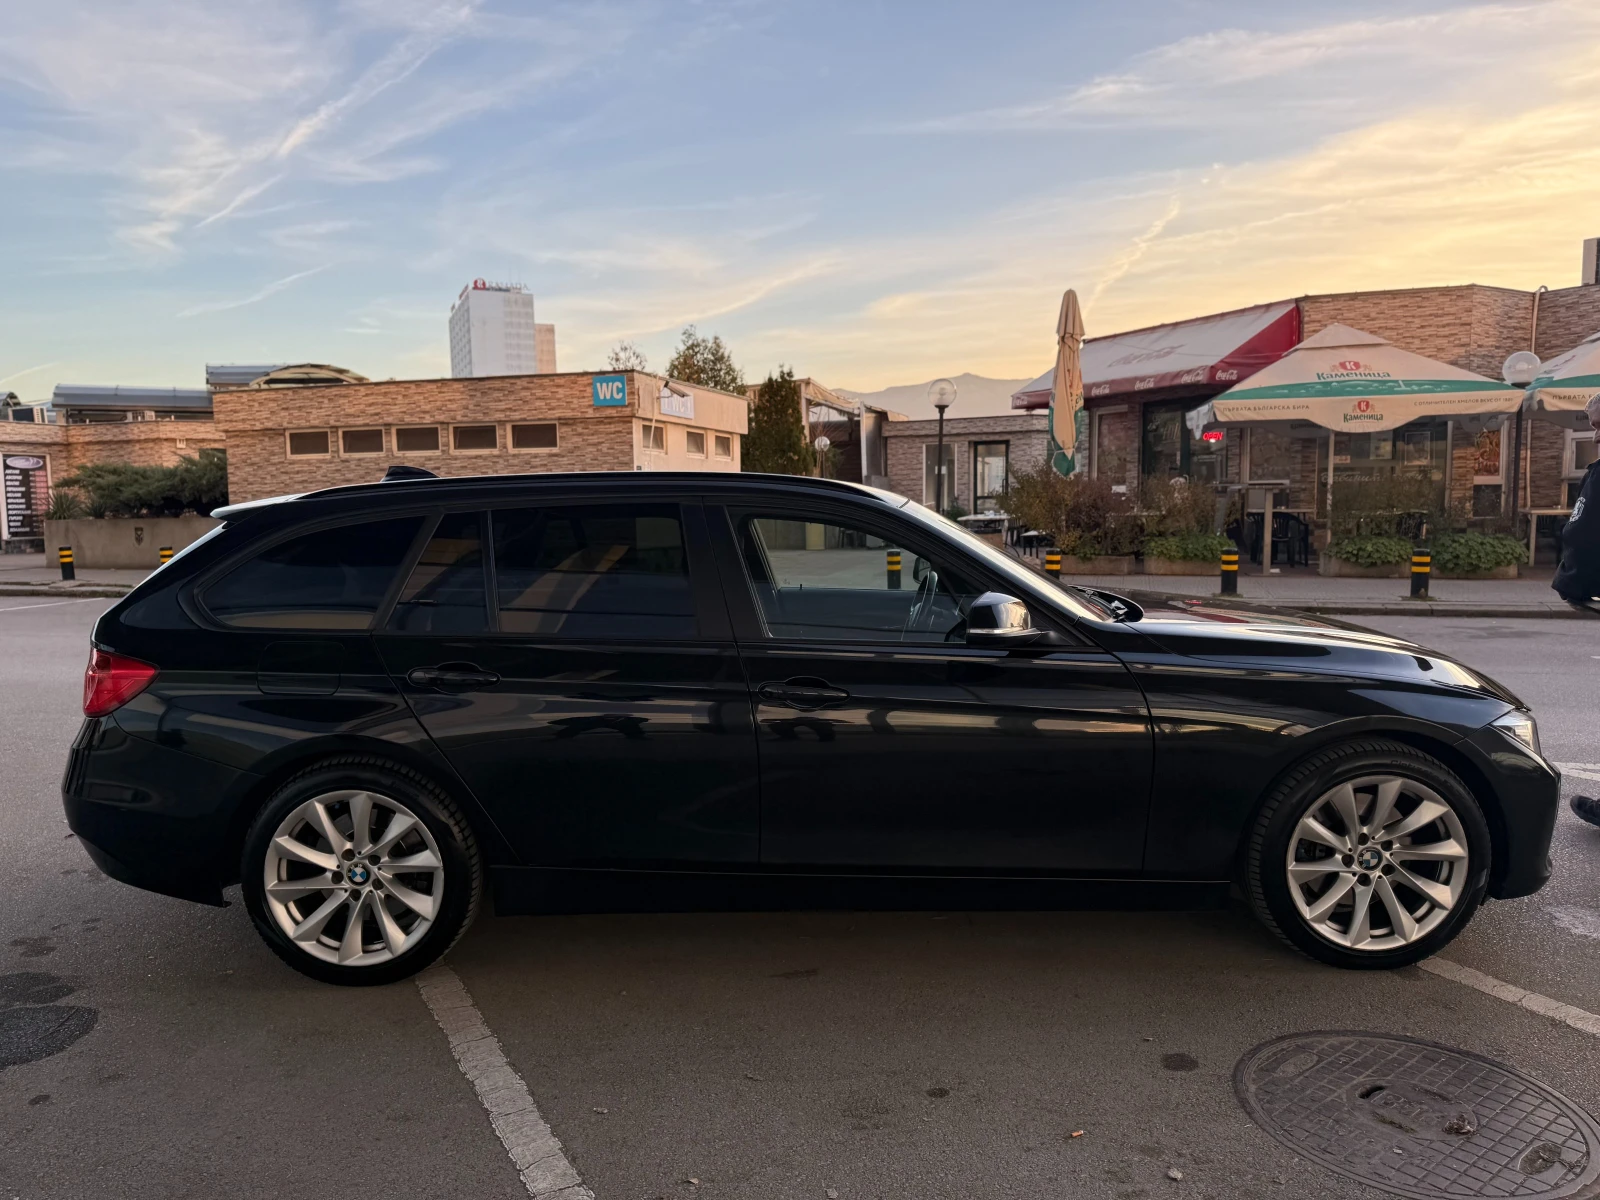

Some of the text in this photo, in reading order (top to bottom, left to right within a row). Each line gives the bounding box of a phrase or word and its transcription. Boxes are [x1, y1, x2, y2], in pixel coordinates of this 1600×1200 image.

[1316, 371, 1391, 381] Каменица
[596, 381, 623, 400] WC
[1343, 413, 1384, 423] Каменица
[1203, 431, 1224, 441] OPEN
